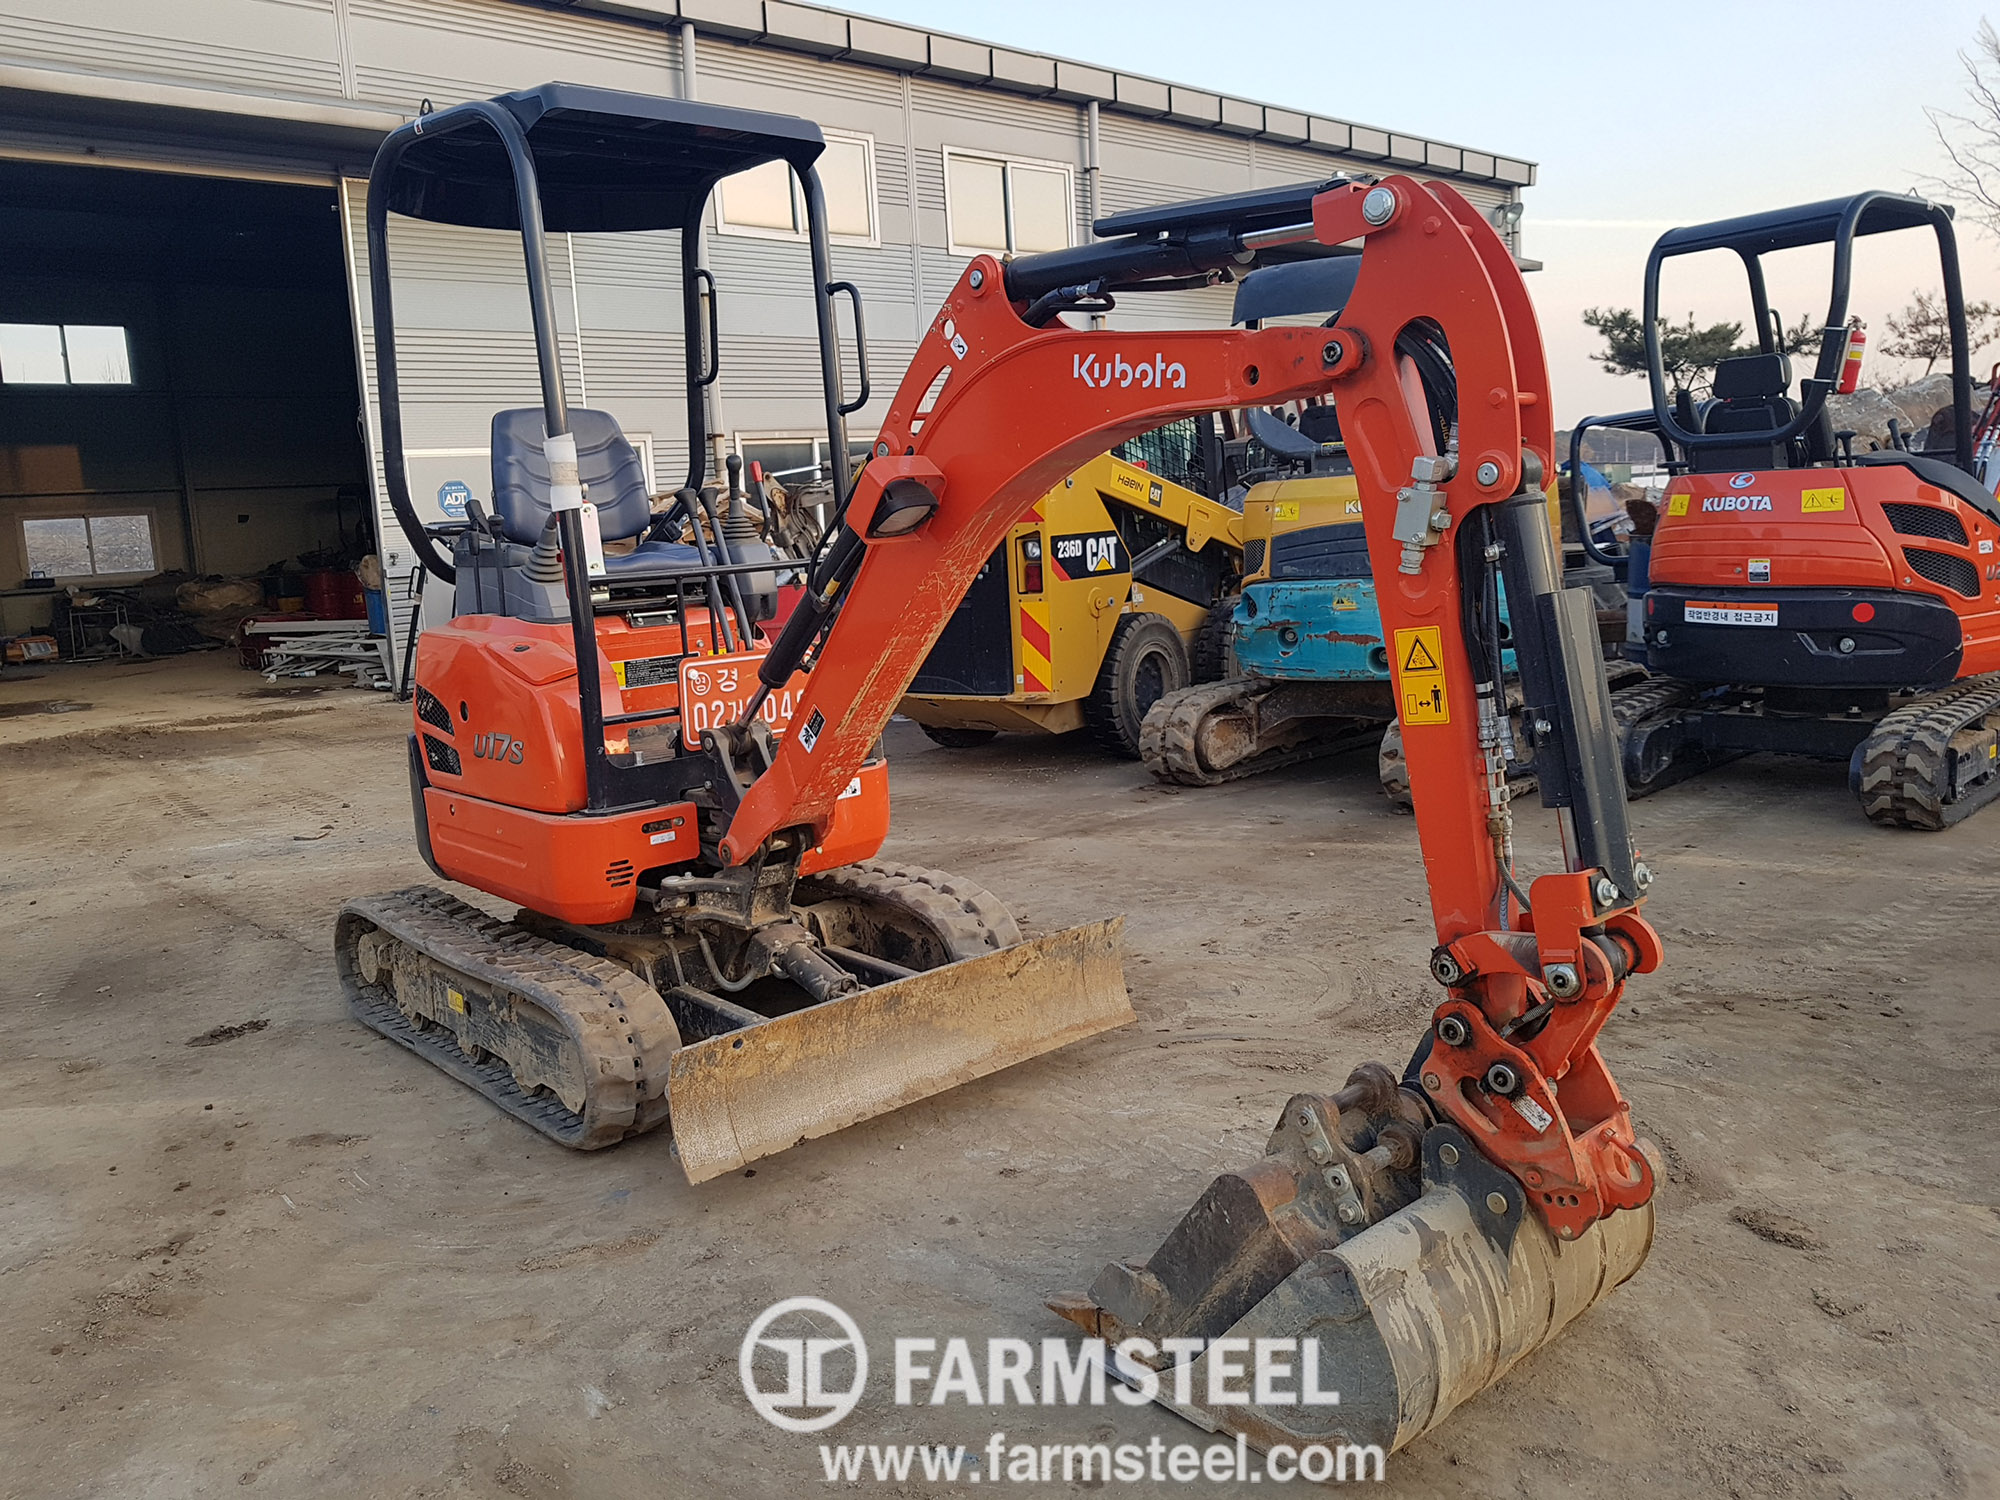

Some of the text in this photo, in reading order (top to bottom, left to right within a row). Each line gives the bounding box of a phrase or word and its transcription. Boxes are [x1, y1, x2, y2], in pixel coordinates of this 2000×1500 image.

[1073, 353, 1186, 388] Kubota
[444, 492, 467, 506] ADT
[1702, 496, 1773, 512] KUBOTA
[1057, 536, 1117, 572] 236D CAT
[716, 667, 738, 692] 경
